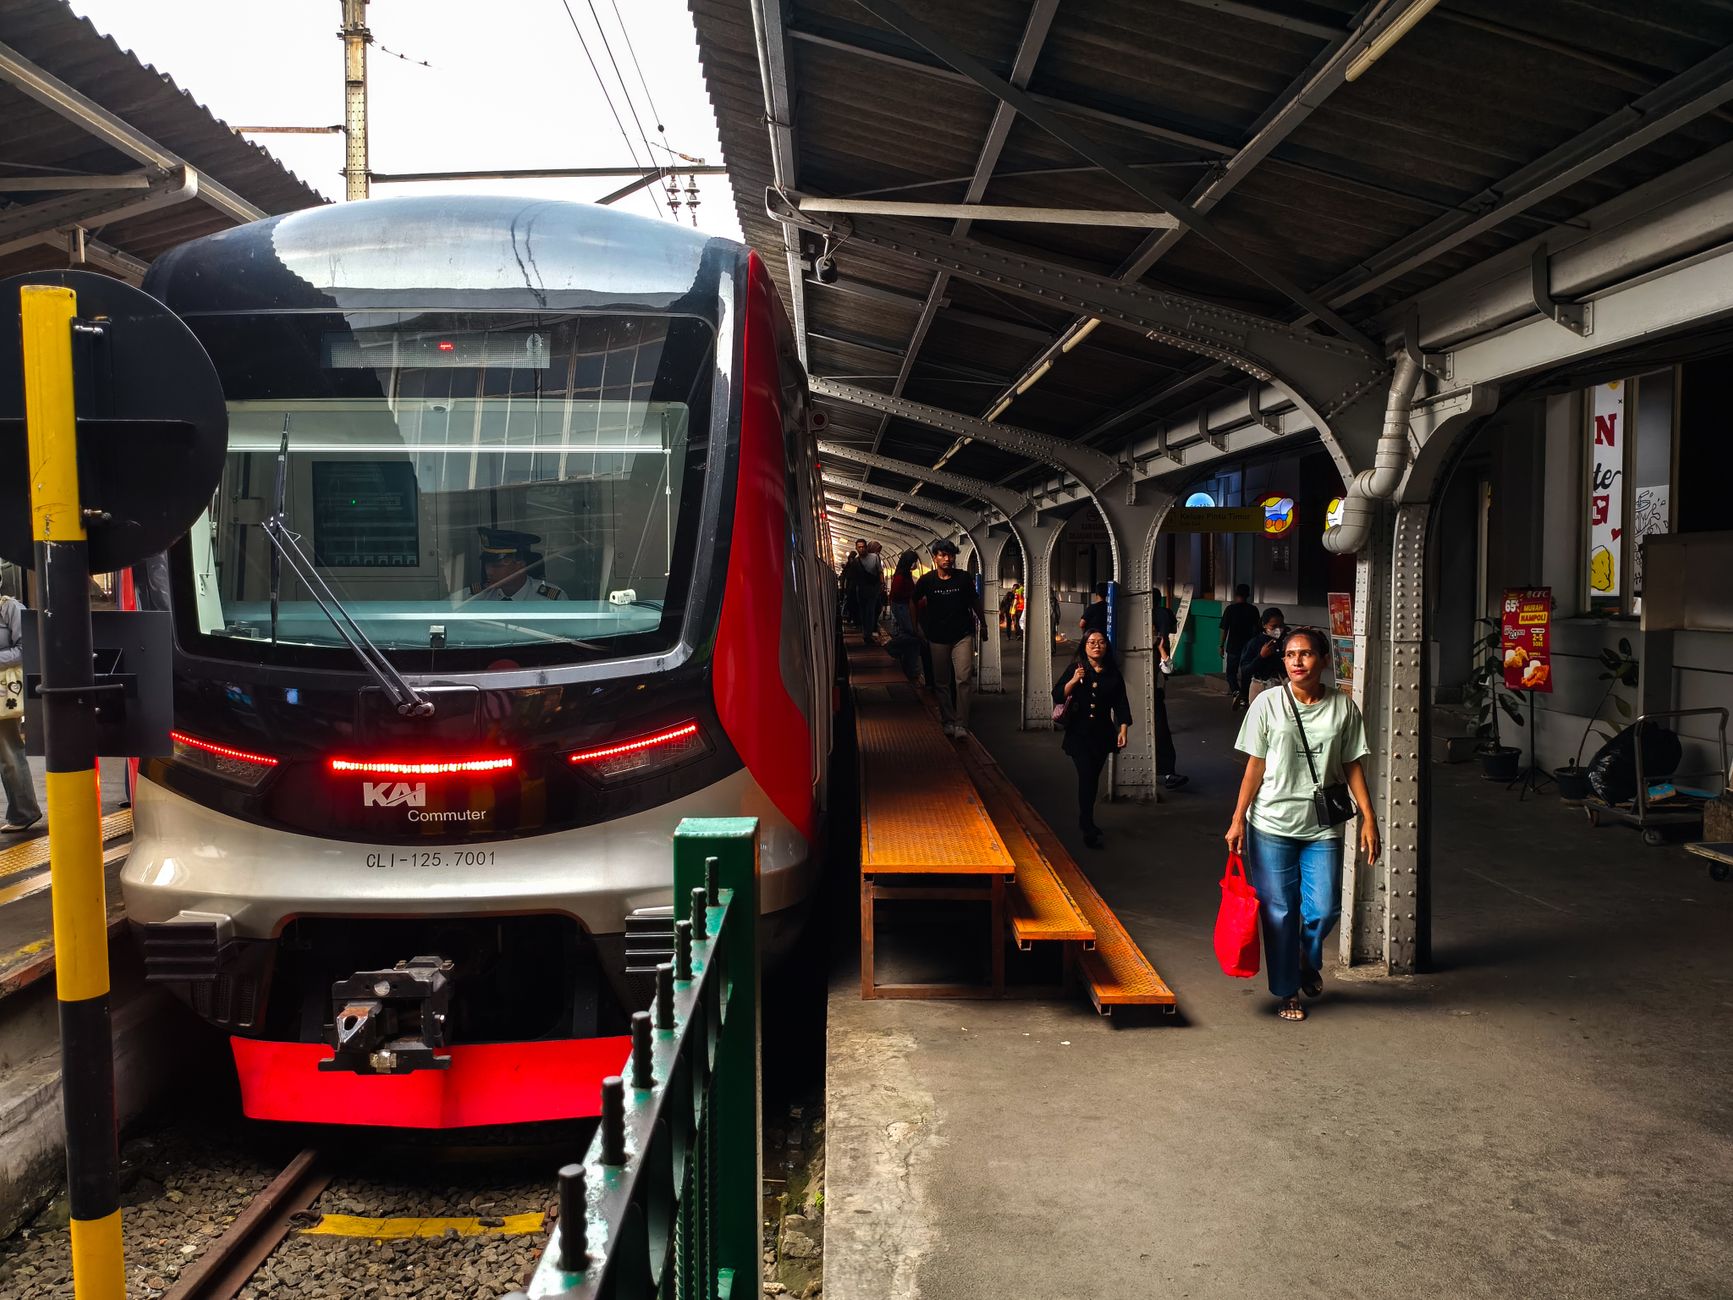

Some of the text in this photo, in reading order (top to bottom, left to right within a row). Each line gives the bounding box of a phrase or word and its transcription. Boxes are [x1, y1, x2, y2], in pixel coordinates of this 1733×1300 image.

[1595, 413, 1617, 447] N
[363, 782, 426, 807] KAI
[407, 809, 487, 822] Commuter
[366, 851, 496, 868] CLI-125.7001
